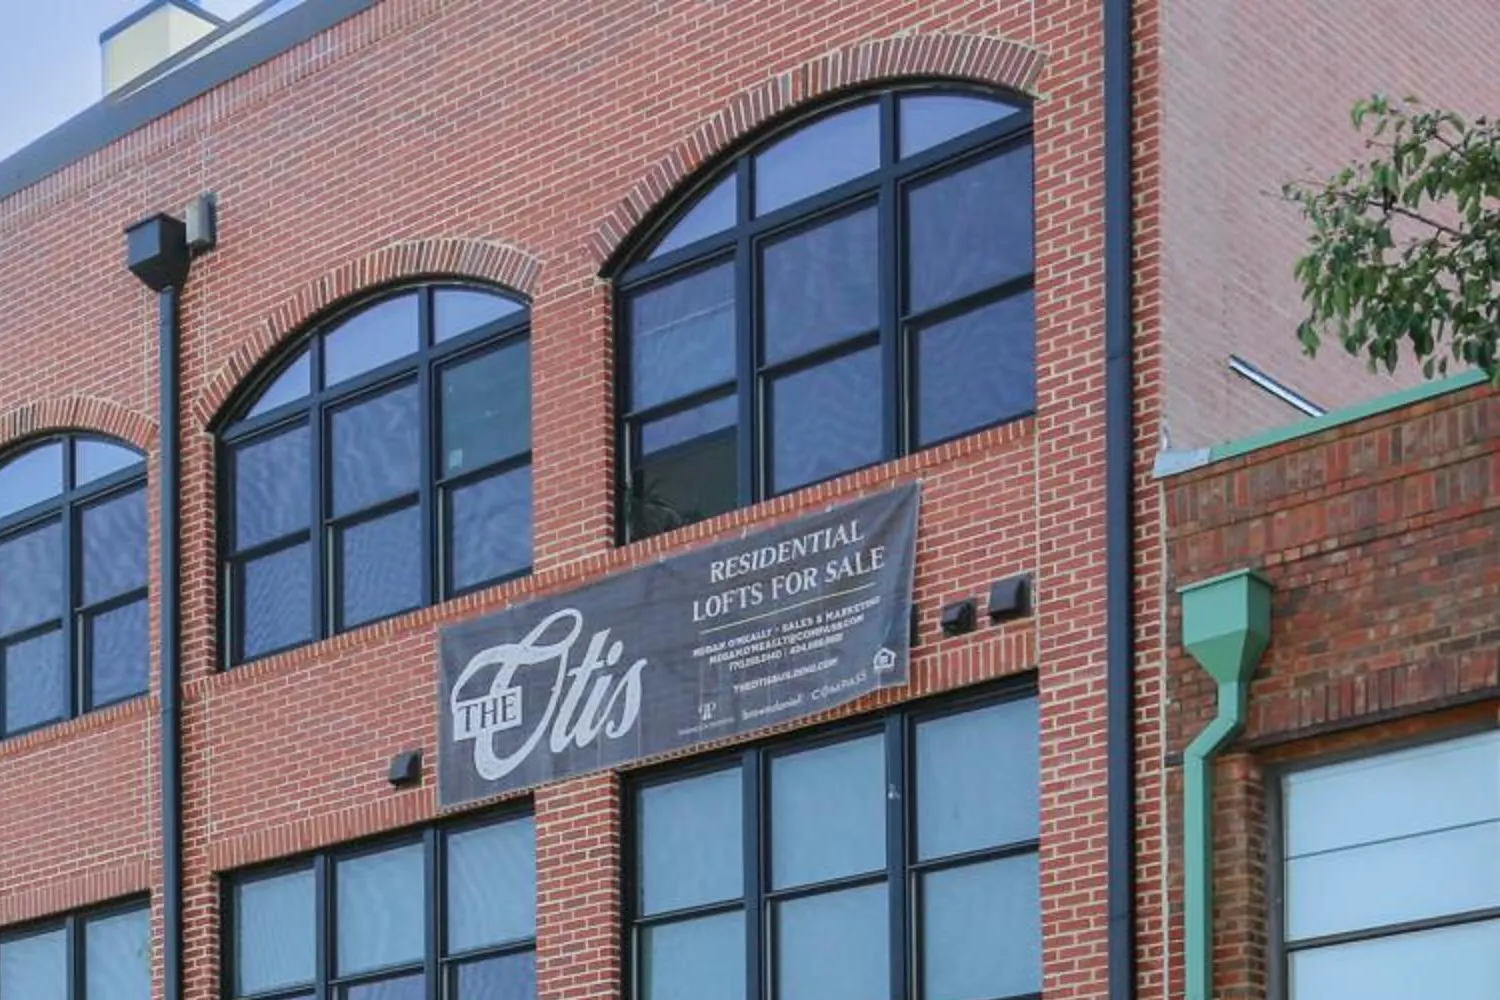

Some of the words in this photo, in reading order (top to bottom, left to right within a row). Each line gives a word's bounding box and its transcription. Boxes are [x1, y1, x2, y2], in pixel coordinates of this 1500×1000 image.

[692, 581, 764, 622] LOFTS
[771, 566, 819, 600] FOR
[824, 545, 886, 583] SALE
[710, 519, 864, 584] RESIDENTIAL
[451, 607, 648, 781] Otis
[457, 691, 518, 733] THE
